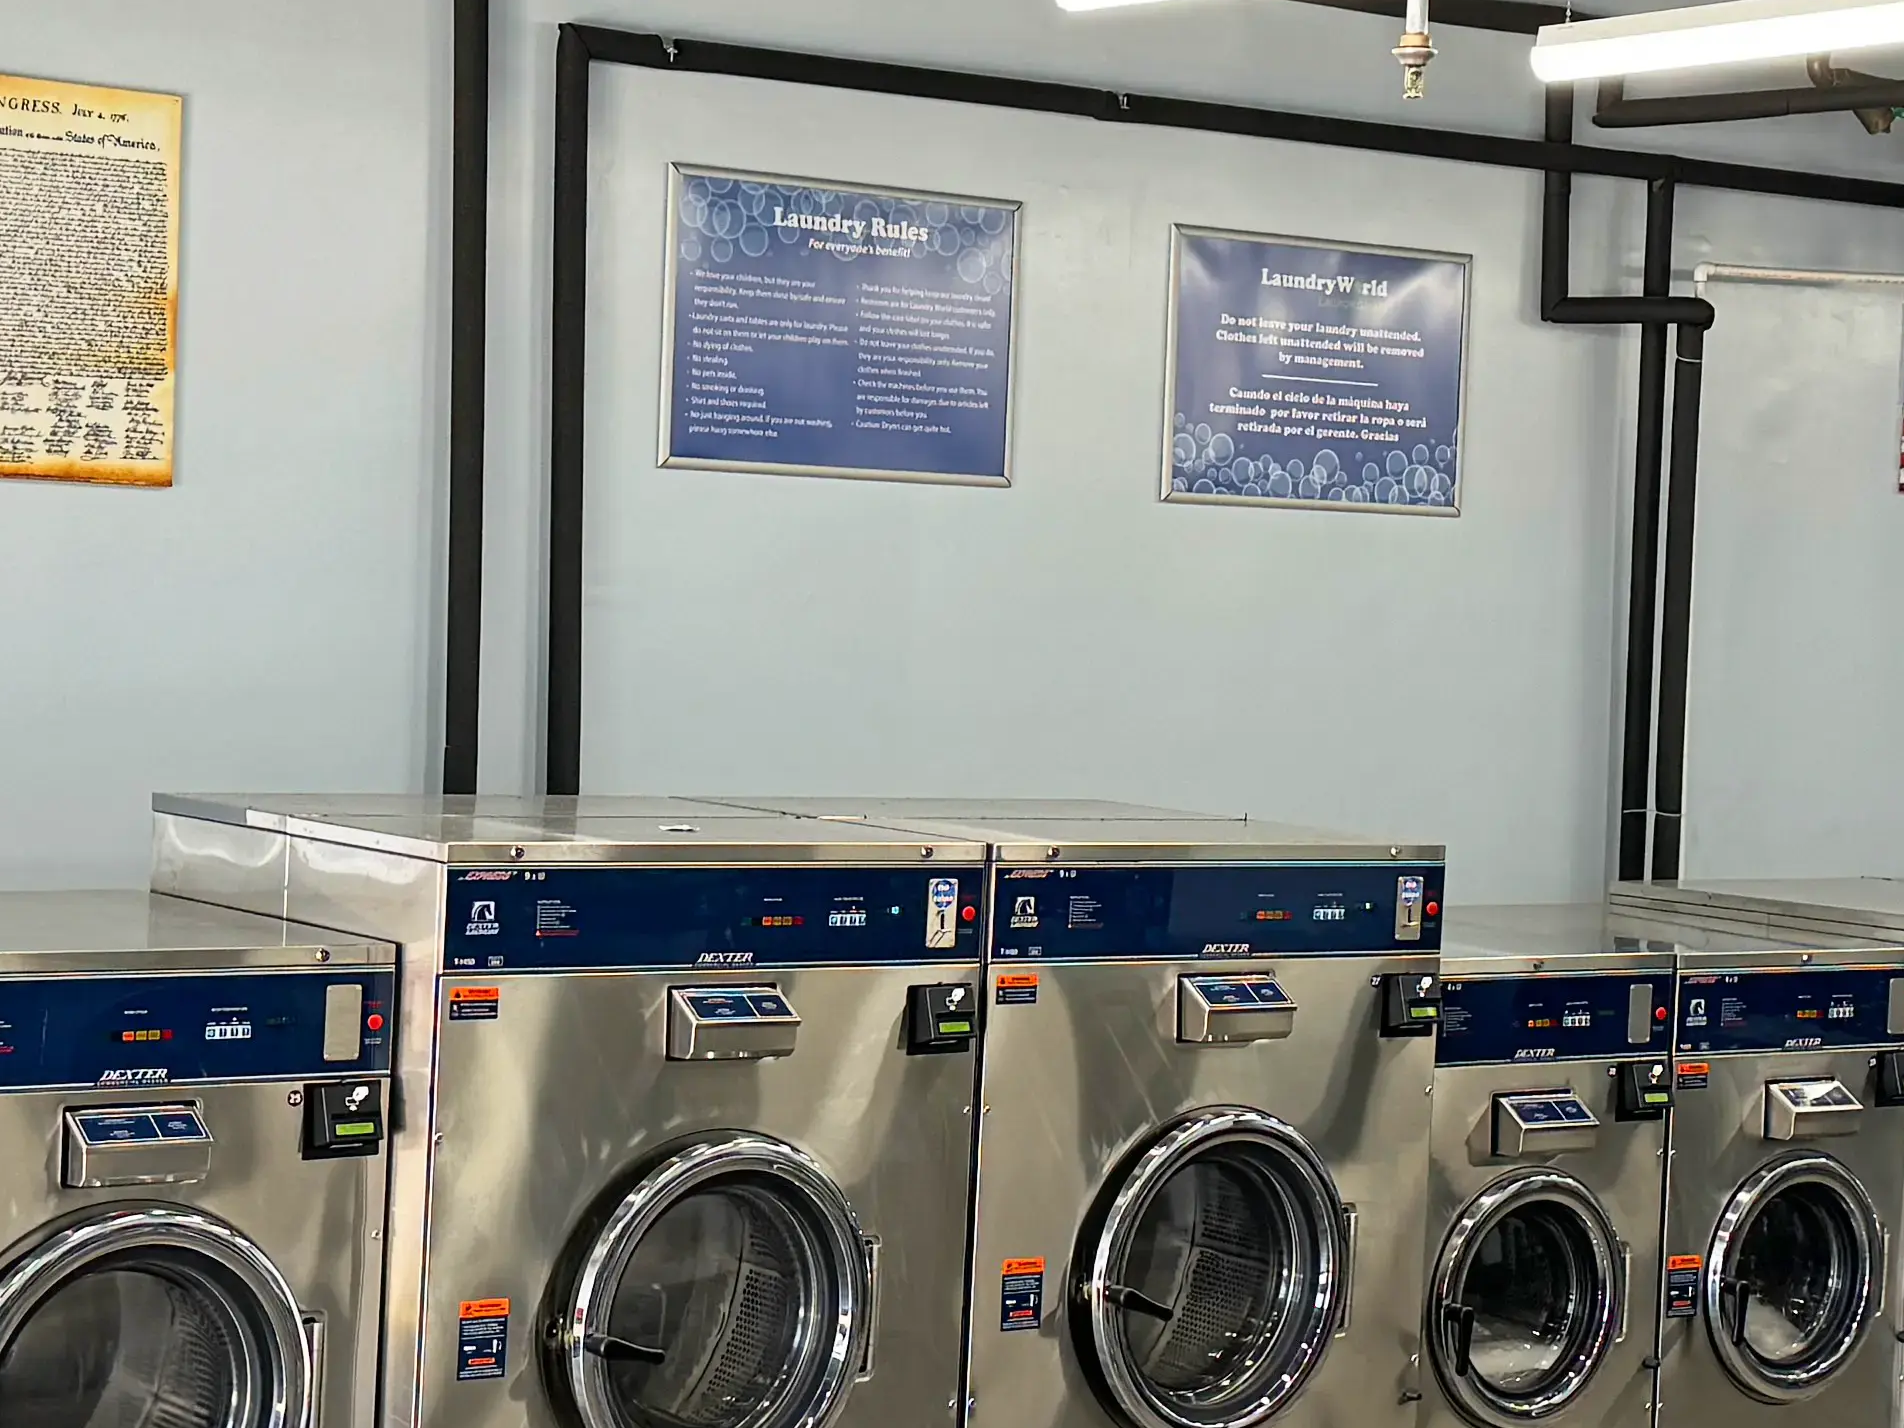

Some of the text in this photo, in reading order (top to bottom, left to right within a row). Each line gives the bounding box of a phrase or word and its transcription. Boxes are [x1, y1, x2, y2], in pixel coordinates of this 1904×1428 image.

[65, 131, 94, 144] States
[774, 207, 929, 241] Laundry Rules
[809, 238, 824, 249] For
[826, 242, 873, 254] everyone's
[1221, 314, 1421, 342] Do not leave your laundry unattended.
[1216, 329, 1424, 358] Clothes left unattended will be removed
[1279, 352, 1364, 369] by management.
[1273, 392, 1282, 401] el
[1285, 392, 1310, 403] ciclo
[1312, 394, 1325, 404] de
[1326, 395, 1336, 405] la
[1386, 400, 1409, 413] haya
[1209, 403, 1265, 417] terminado
[1271, 408, 1290, 419] por
[1292, 407, 1320, 420] favor
[1322, 412, 1358, 423] retirar
[1360, 413, 1369, 423] la
[1371, 415, 1394, 427] ropa
[1237, 421, 1399, 442] retirada por el gerente. Gracias
[697, 952, 753, 963] DEXTER
[100, 1068, 168, 1080] DEXTER
